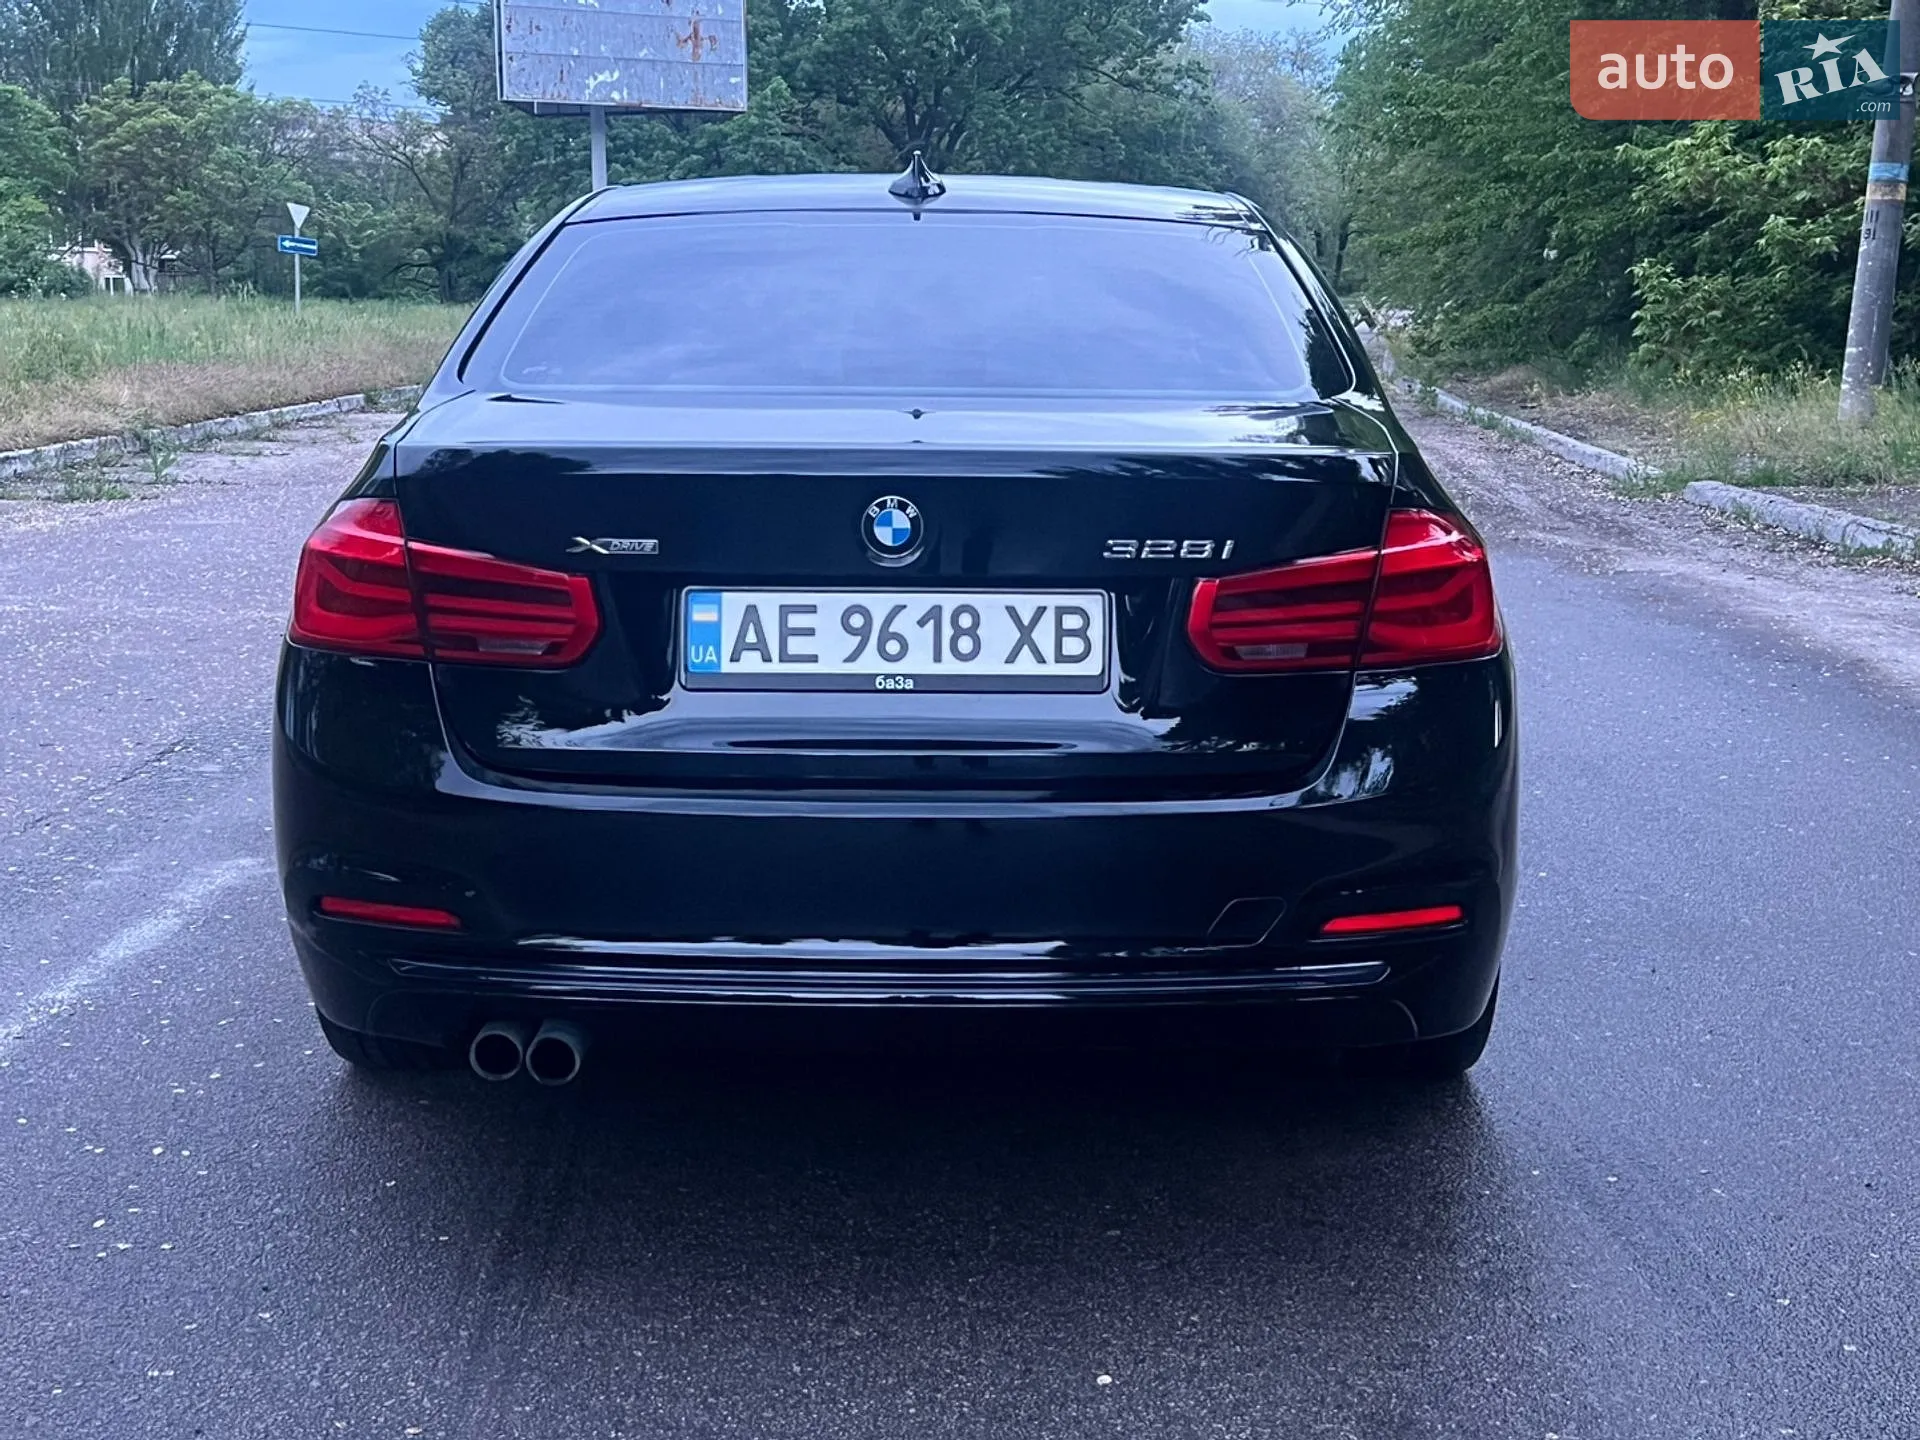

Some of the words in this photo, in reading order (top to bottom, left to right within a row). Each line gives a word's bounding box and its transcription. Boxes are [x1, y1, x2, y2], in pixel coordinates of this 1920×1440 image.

[868, 498, 917, 518] BMW
[1103, 540, 1234, 559] 328i
[729, 604, 819, 663] AE
[840, 604, 982, 663] 9618
[1004, 605, 1092, 665] XB
[690, 645, 718, 664] UA
